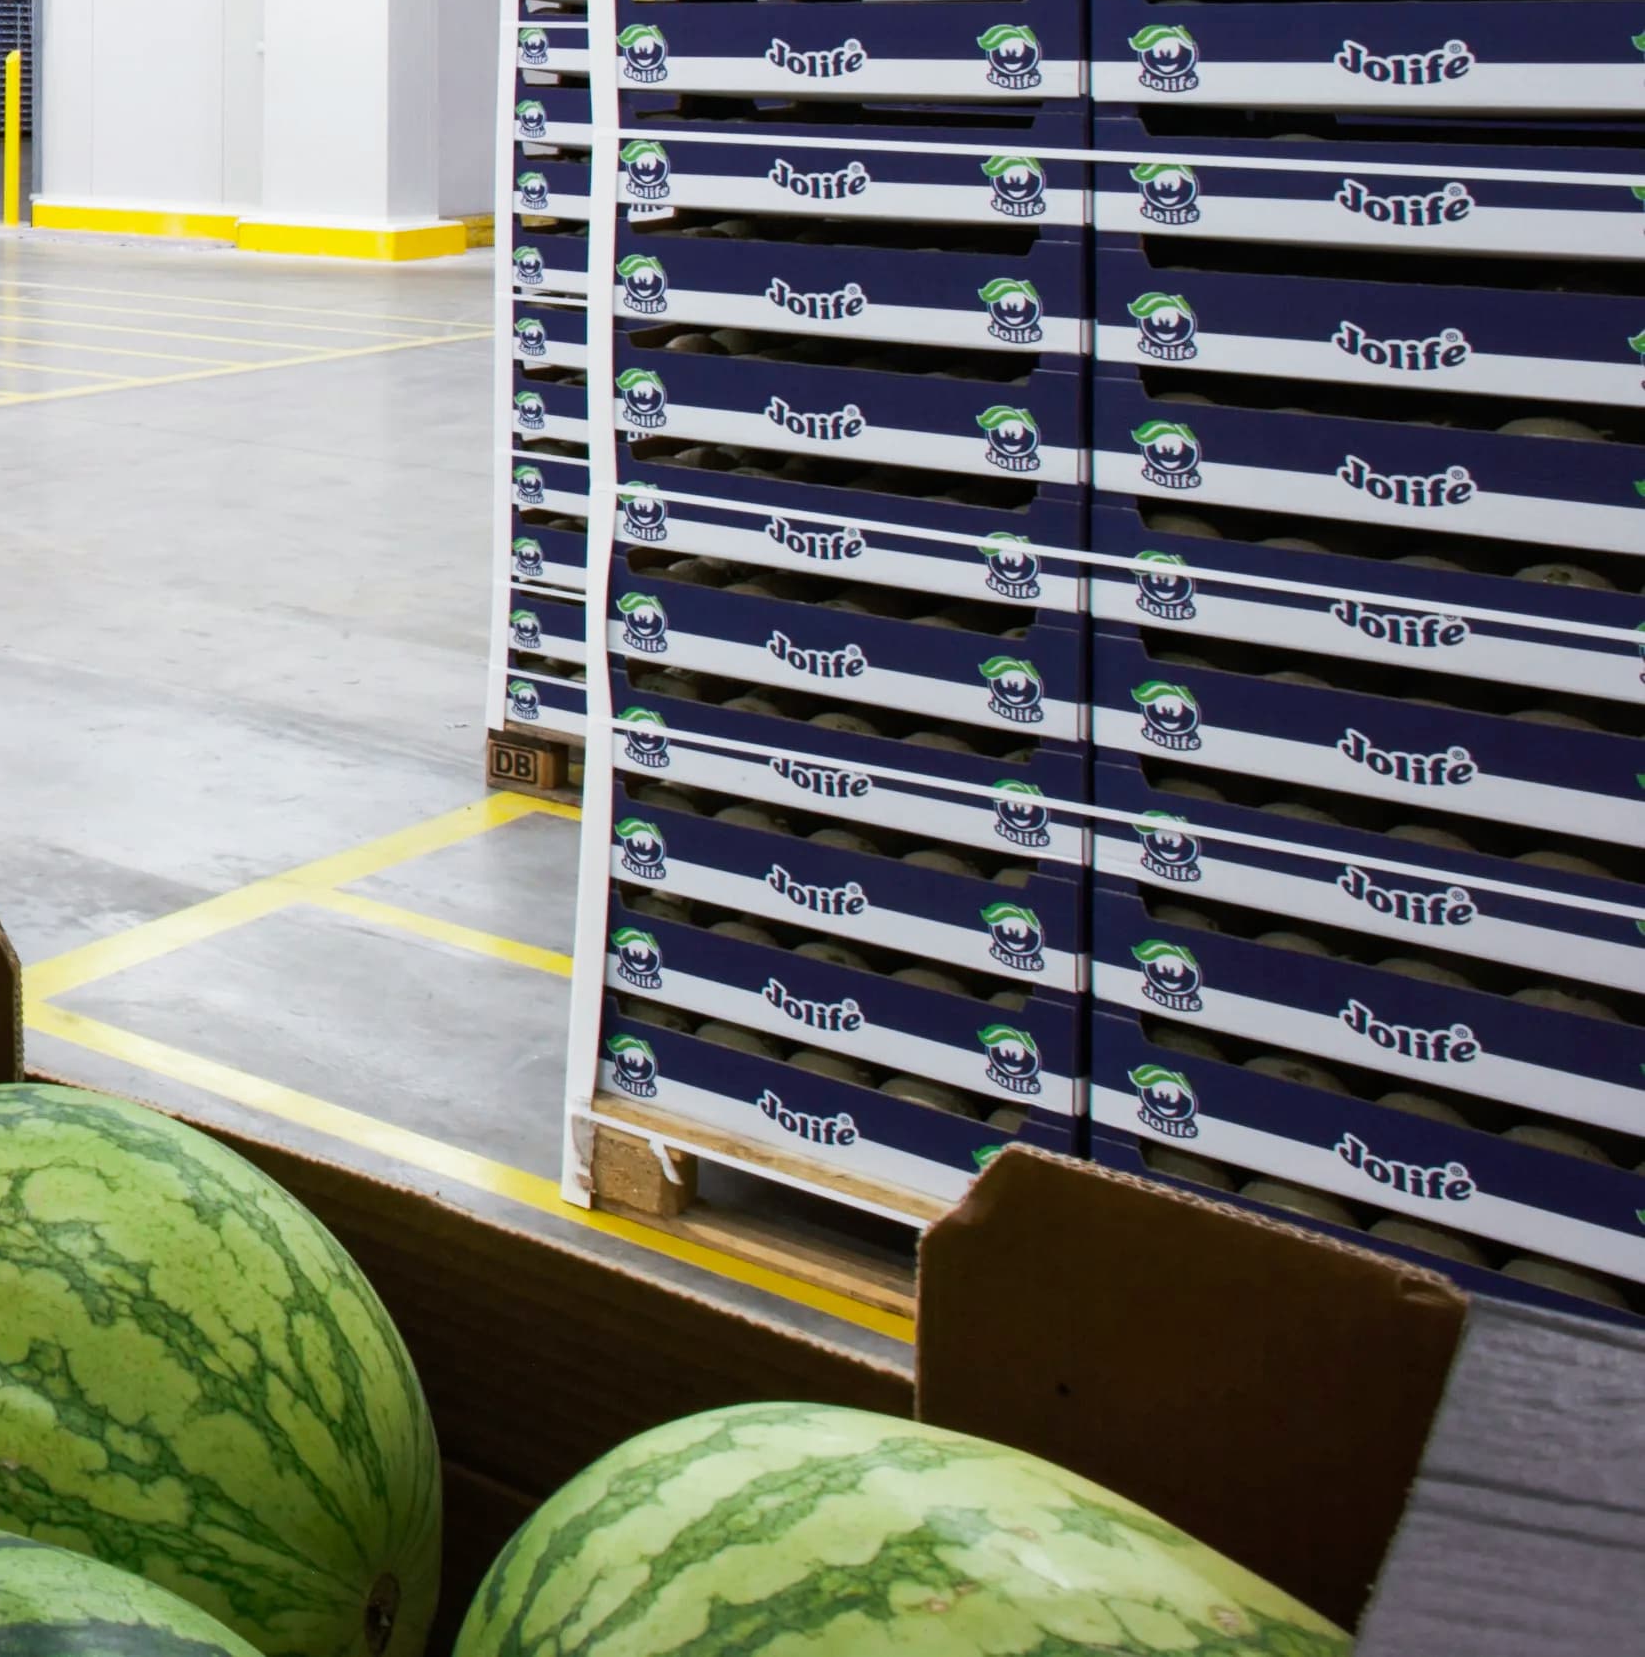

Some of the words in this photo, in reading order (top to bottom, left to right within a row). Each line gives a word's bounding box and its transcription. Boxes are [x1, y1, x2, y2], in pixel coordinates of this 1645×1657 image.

[769, 40, 863, 77] Jolife
[1339, 43, 1470, 85] Jolife
[625, 68, 667, 82] Jolife
[987, 71, 1041, 89] Jolife
[1139, 73, 1198, 92] Jolife
[627, 184, 669, 198] Jolife
[772, 162, 866, 198] Jolife
[990, 198, 1045, 216] Jolife
[1141, 205, 1199, 224] Jolife
[1340, 183, 1470, 226] Jolife
[624, 298, 667, 313] Jolife
[769, 280, 863, 319] Jolife
[988, 325, 1042, 344] Jolife
[1138, 340, 1197, 361] Jolife
[1337, 325, 1466, 370] Jolife
[624, 411, 665, 427] Jolife
[768, 399, 861, 439] Jolife
[986, 452, 1040, 471] Jolife
[1142, 468, 1201, 489] Jolife
[1342, 460, 1473, 507] Jolife
[624, 523, 666, 540] Jolife
[769, 519, 862, 560] Jolife
[986, 578, 1040, 598] Jolife
[1137, 596, 1195, 620] Jolife
[1335, 602, 1466, 647] Jolife
[624, 634, 667, 652] Jolife
[770, 634, 864, 677] Jolife
[988, 700, 1043, 723] Jolife
[1142, 727, 1201, 750] Jolife
[496, 749, 531, 777] DB
[626, 748, 669, 766] Jolife
[1342, 733, 1473, 786] Jolife
[774, 759, 868, 798] Jolife
[995, 824, 1049, 847] Jolife
[623, 857, 665, 879] Jolife
[1141, 856, 1200, 881] Jolife
[769, 867, 864, 914] Jolife
[1342, 870, 1473, 925] Jolife
[989, 947, 1044, 971] Jolife
[619, 966, 661, 988] Jolife
[766, 981, 860, 1030] Jolife
[1143, 984, 1202, 1011] Jolife
[1344, 1004, 1476, 1062] Jolife
[613, 1073, 656, 1097] Jolife
[986, 1067, 1040, 1094] Jolife
[760, 1092, 855, 1144] Jolife
[1138, 1109, 1197, 1138] Jolife
[1339, 1138, 1472, 1201] Jolife
